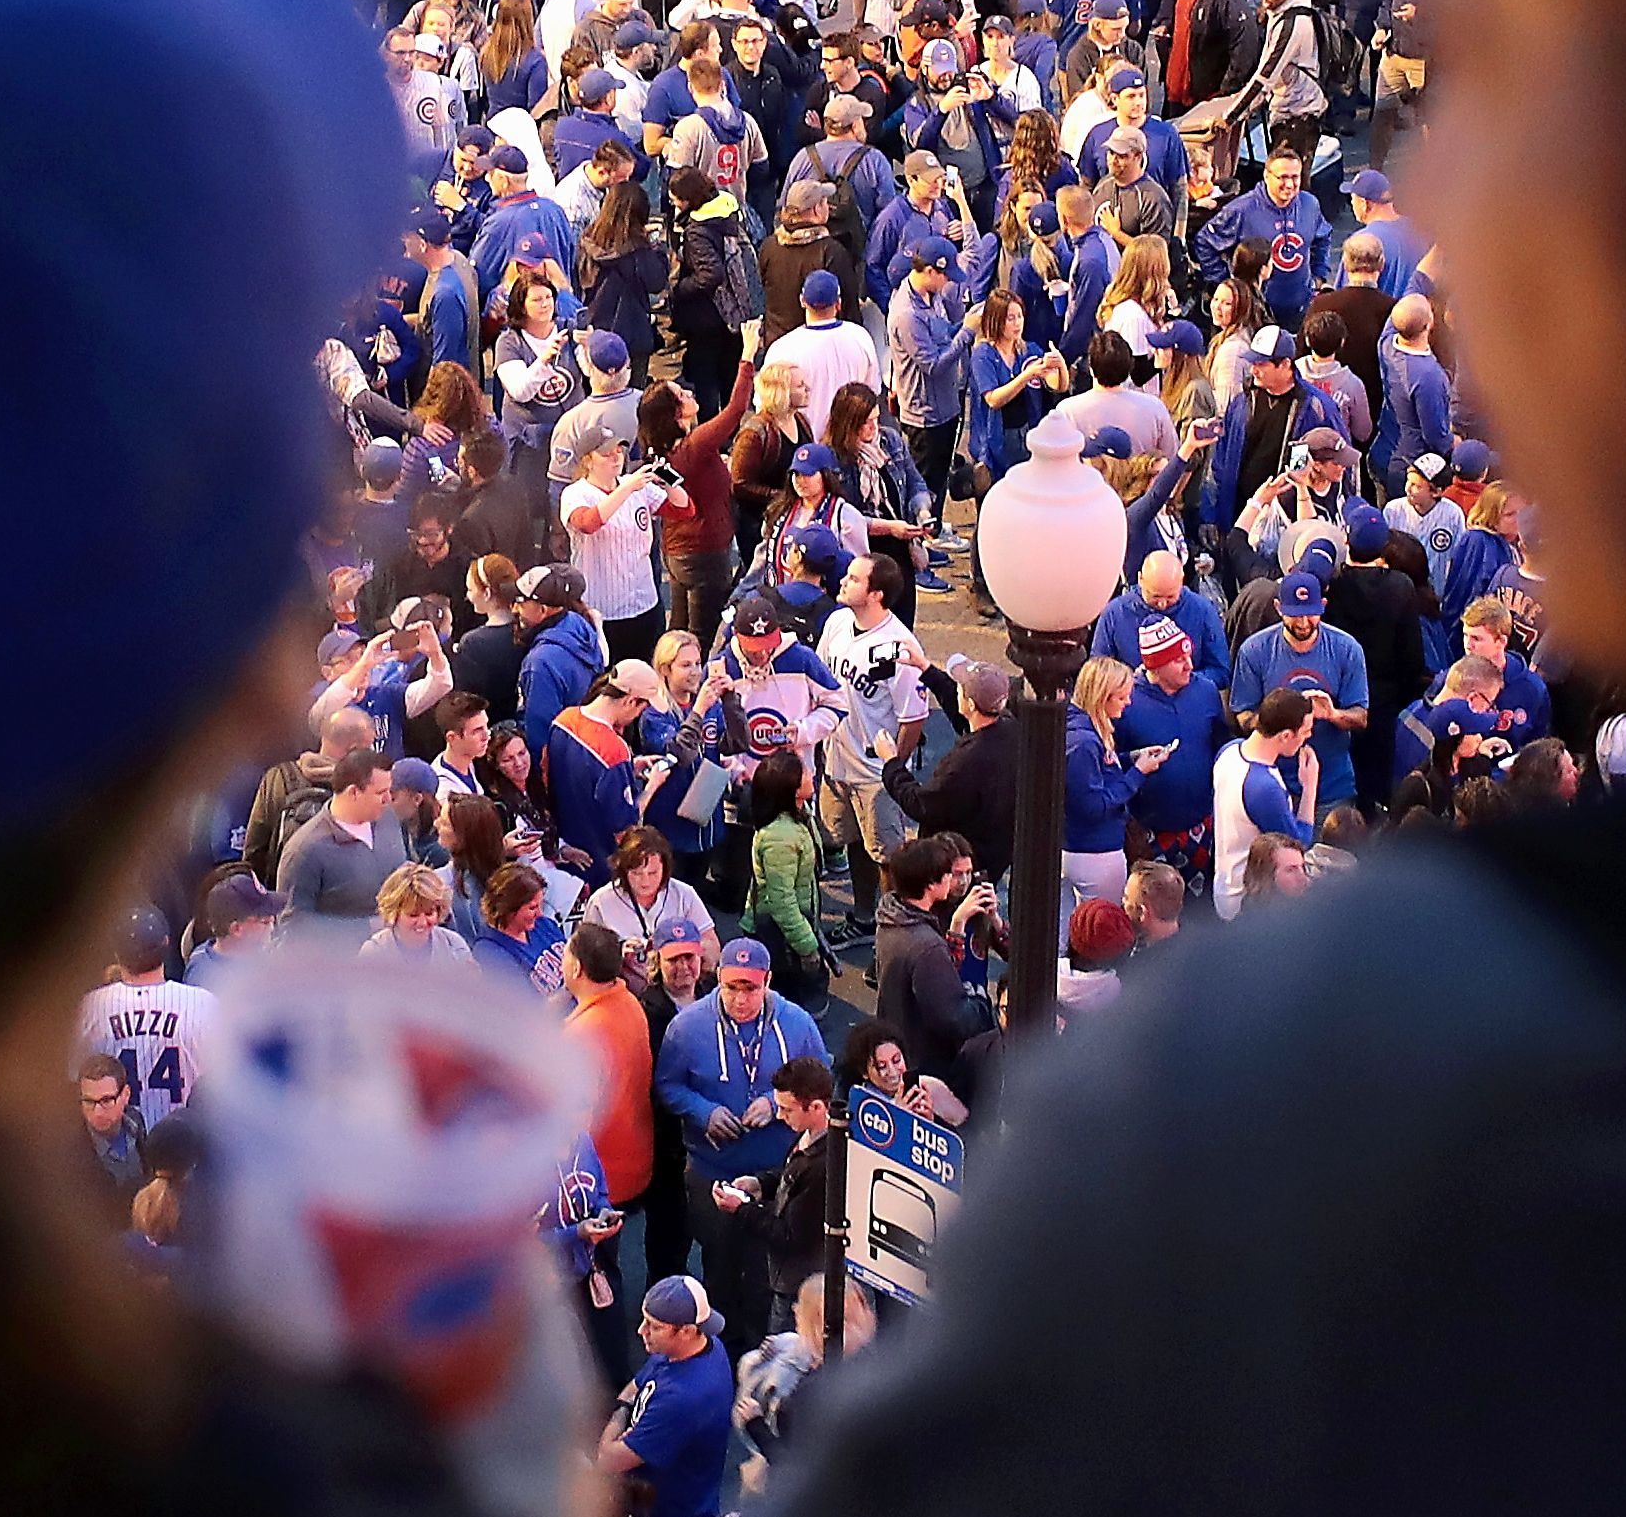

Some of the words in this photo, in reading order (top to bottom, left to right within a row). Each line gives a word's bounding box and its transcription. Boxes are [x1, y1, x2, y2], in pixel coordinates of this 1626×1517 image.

[717, 144, 740, 185] 9
[827, 652, 878, 700] ICAGO
[108, 1010, 179, 1041] RIZZO
[117, 1046, 185, 1107] 44
[863, 1110, 891, 1134] cta
[912, 1118, 949, 1156] bus
[910, 1144, 955, 1183] stop
